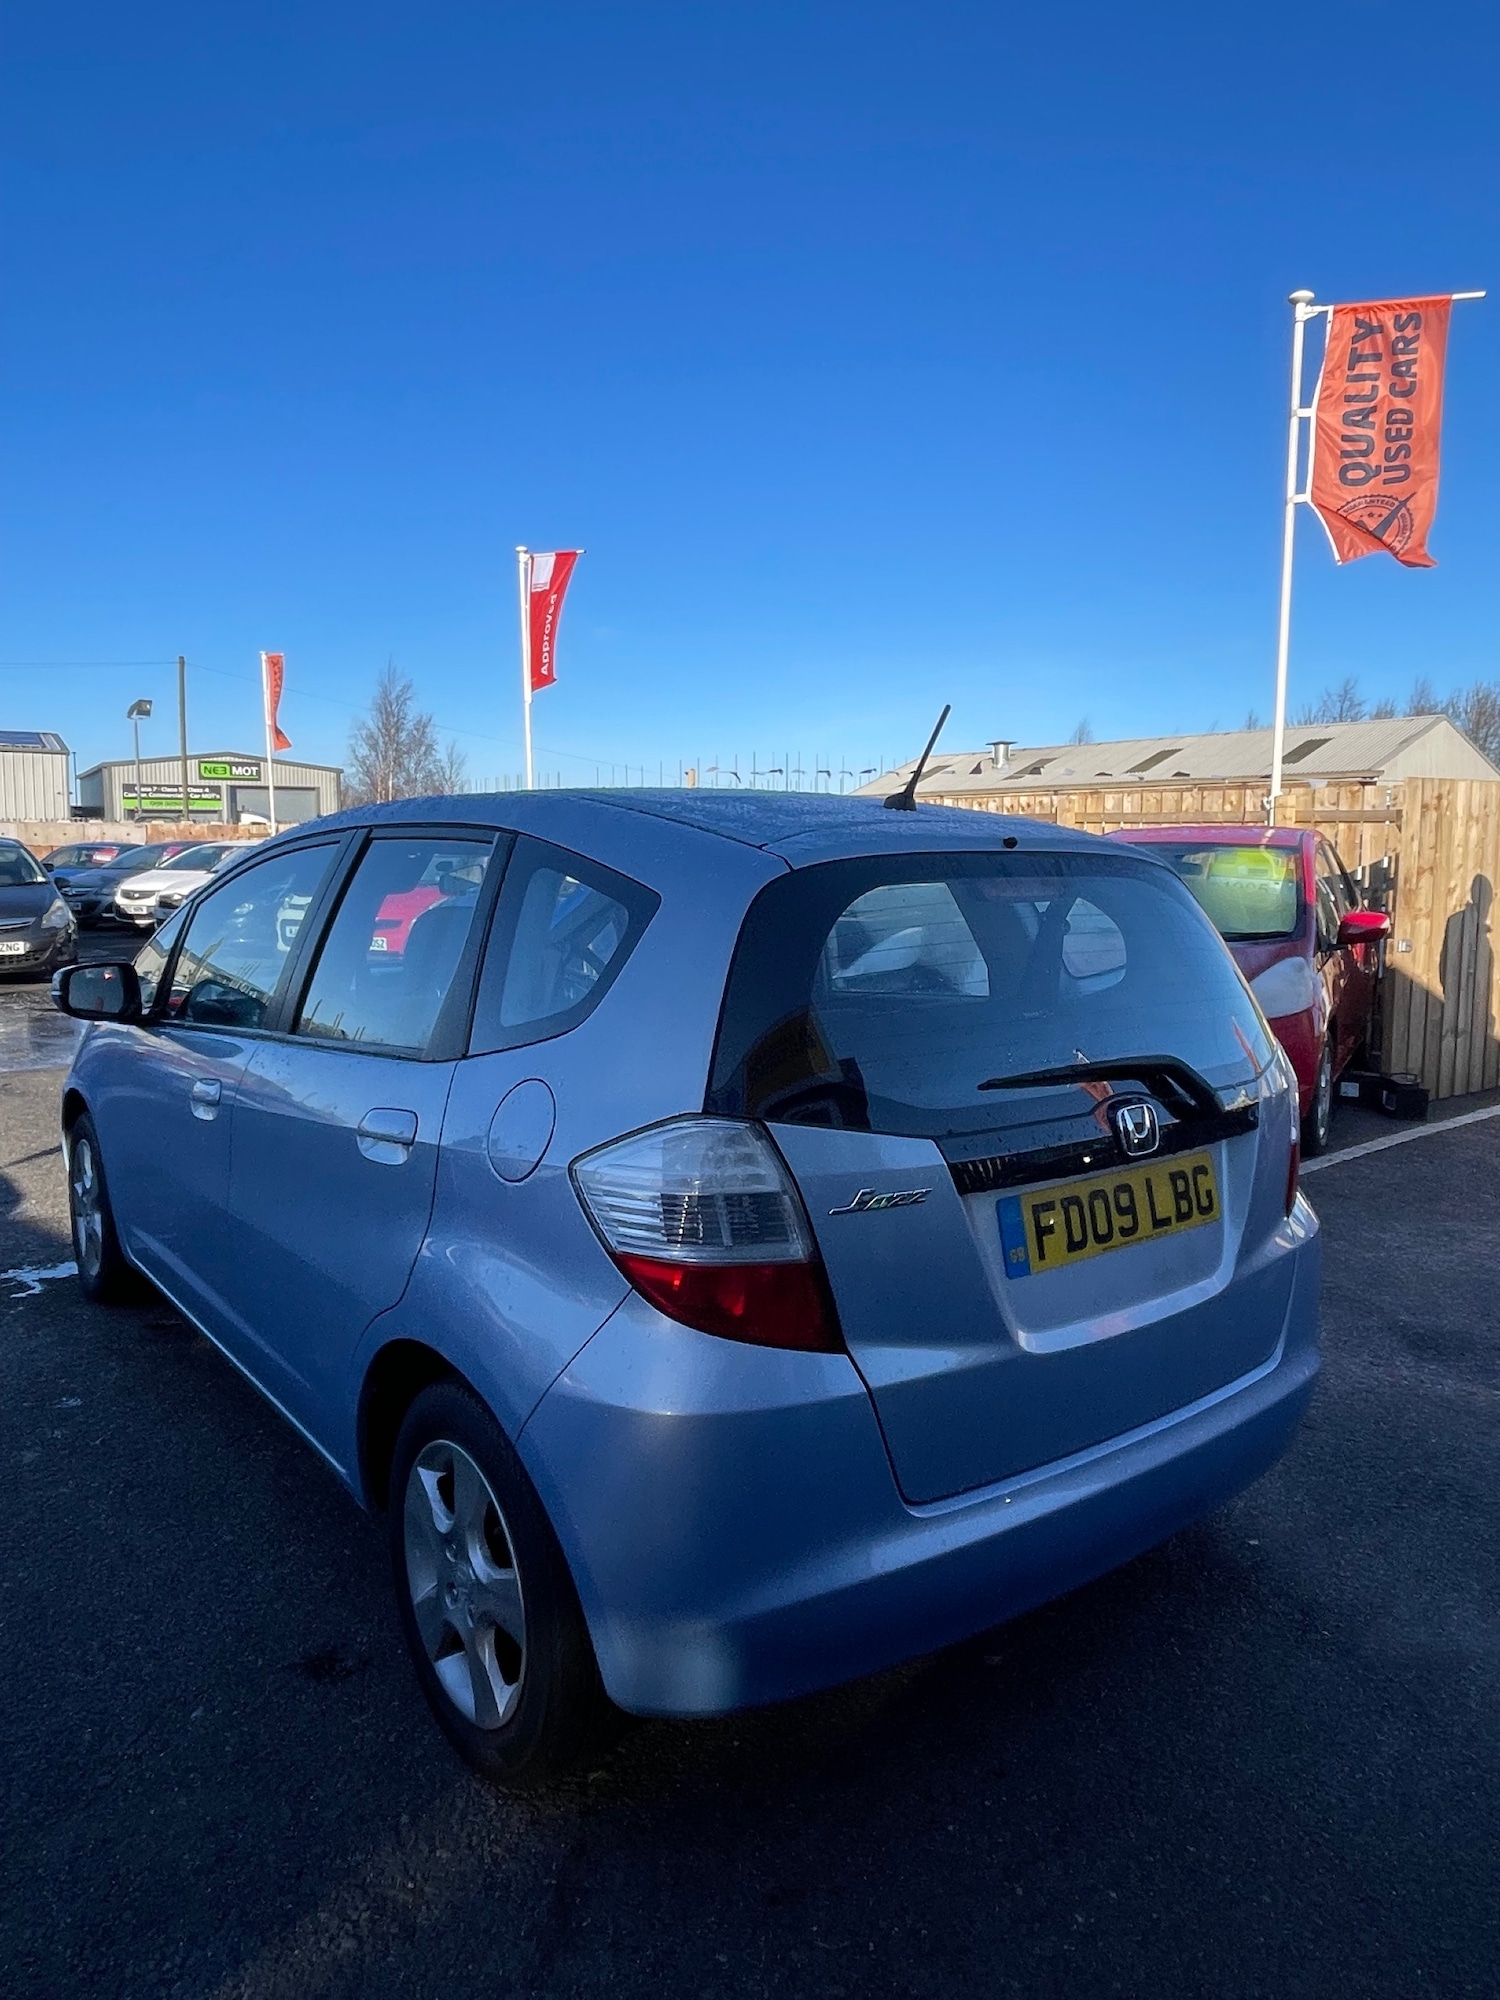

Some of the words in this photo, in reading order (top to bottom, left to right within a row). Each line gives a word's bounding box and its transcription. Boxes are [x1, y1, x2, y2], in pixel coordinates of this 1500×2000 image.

[1389, 312, 1422, 399] CARS
[1338, 317, 1384, 487] QUALITY
[1382, 407, 1414, 486] USED
[232, 766, 259, 776] MOT
[1032, 1183, 1139, 1262] FD09
[1145, 1165, 1214, 1230] LBG
